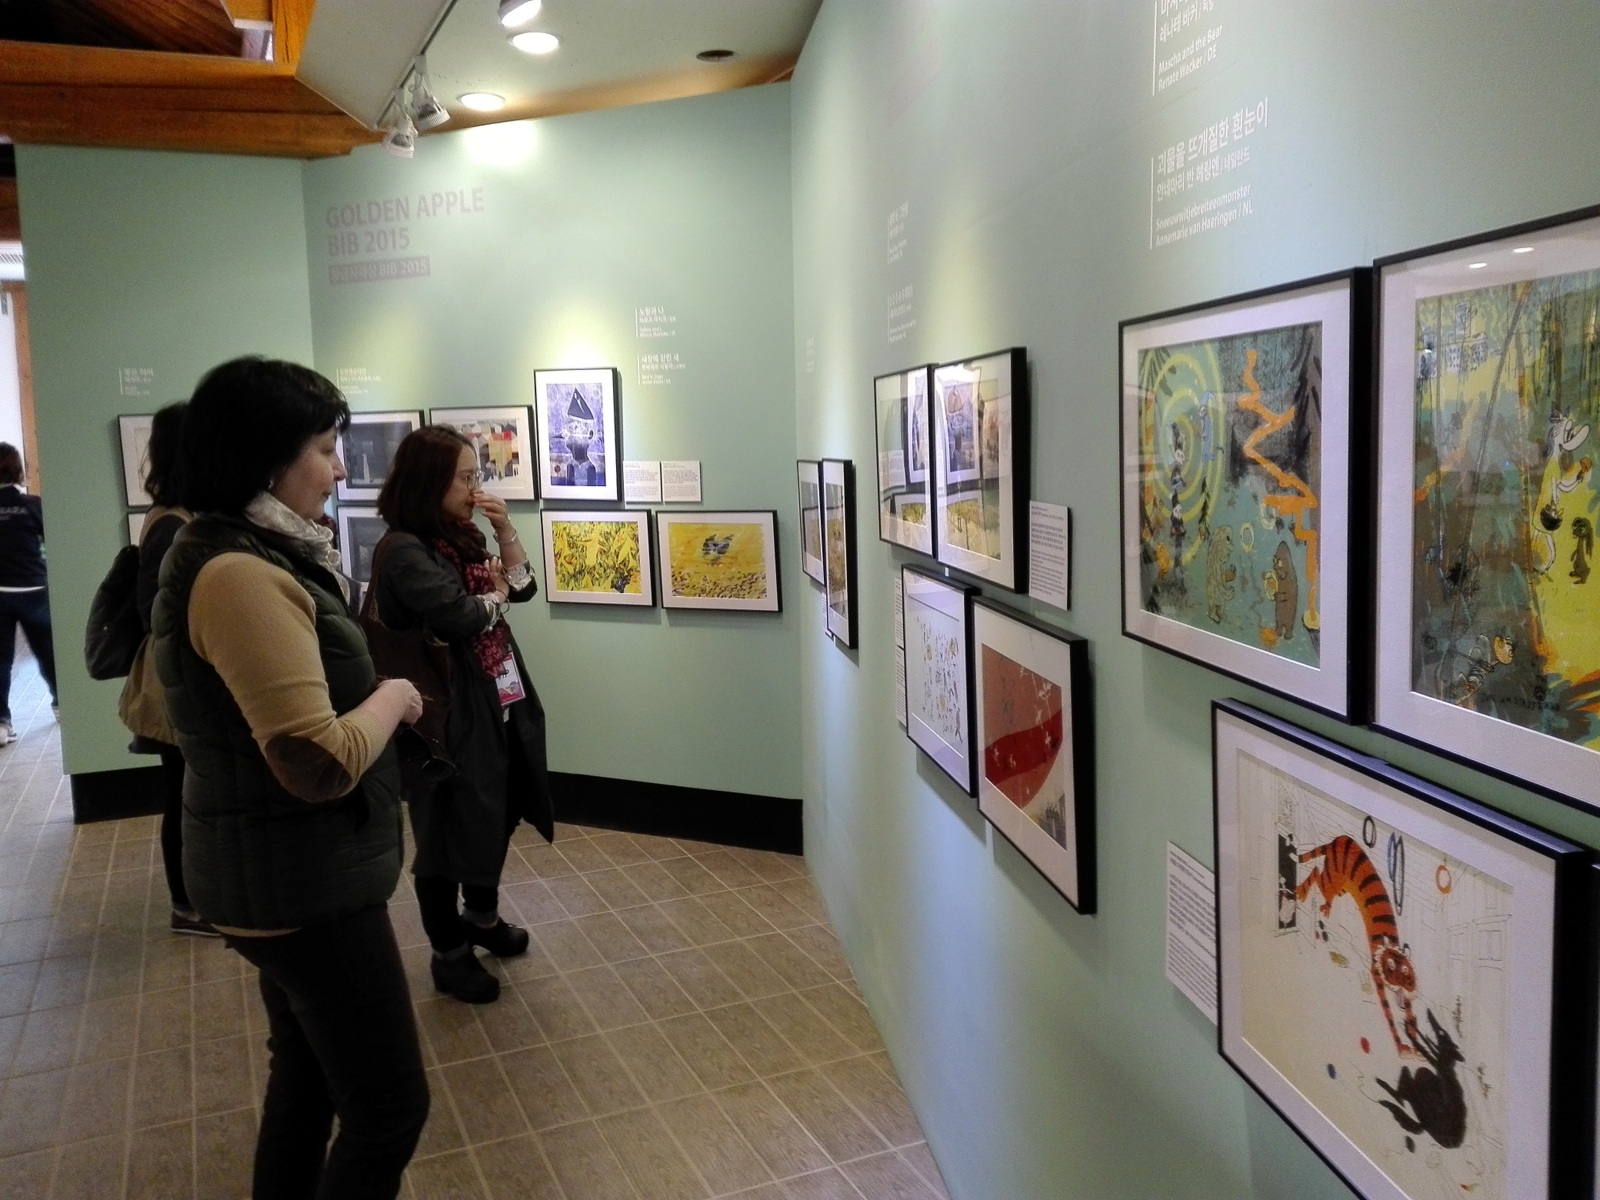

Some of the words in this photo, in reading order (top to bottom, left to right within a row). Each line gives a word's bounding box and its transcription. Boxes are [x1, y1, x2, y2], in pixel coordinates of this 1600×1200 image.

[1158, 52, 1181, 75] Mascha
[1182, 41, 1194, 60] and
[1195, 35, 1207, 51] the
[1207, 25, 1223, 44] Bear
[1180, 54, 1203, 79] Wacker
[1207, 43, 1218, 62] DE
[1158, 141, 1185, 175] 괴물을
[1187, 116, 1229, 161] 뜨개질한
[1232, 96, 1269, 141] 흰눈이
[1187, 167, 1194, 189] 반
[1224, 145, 1251, 172] 네덜란드
[326, 196, 410, 228] GOLDEN
[416, 187, 485, 218] APPLE
[1155, 225, 1189, 248] Annemarie
[1189, 221, 1201, 236] van
[1201, 208, 1237, 233] Haeringen
[1242, 199, 1254, 217] NL
[328, 232, 359, 256] BIB
[364, 226, 410, 253] 2015
[379, 261, 398, 278] BIB
[400, 259, 428, 275] 2015
